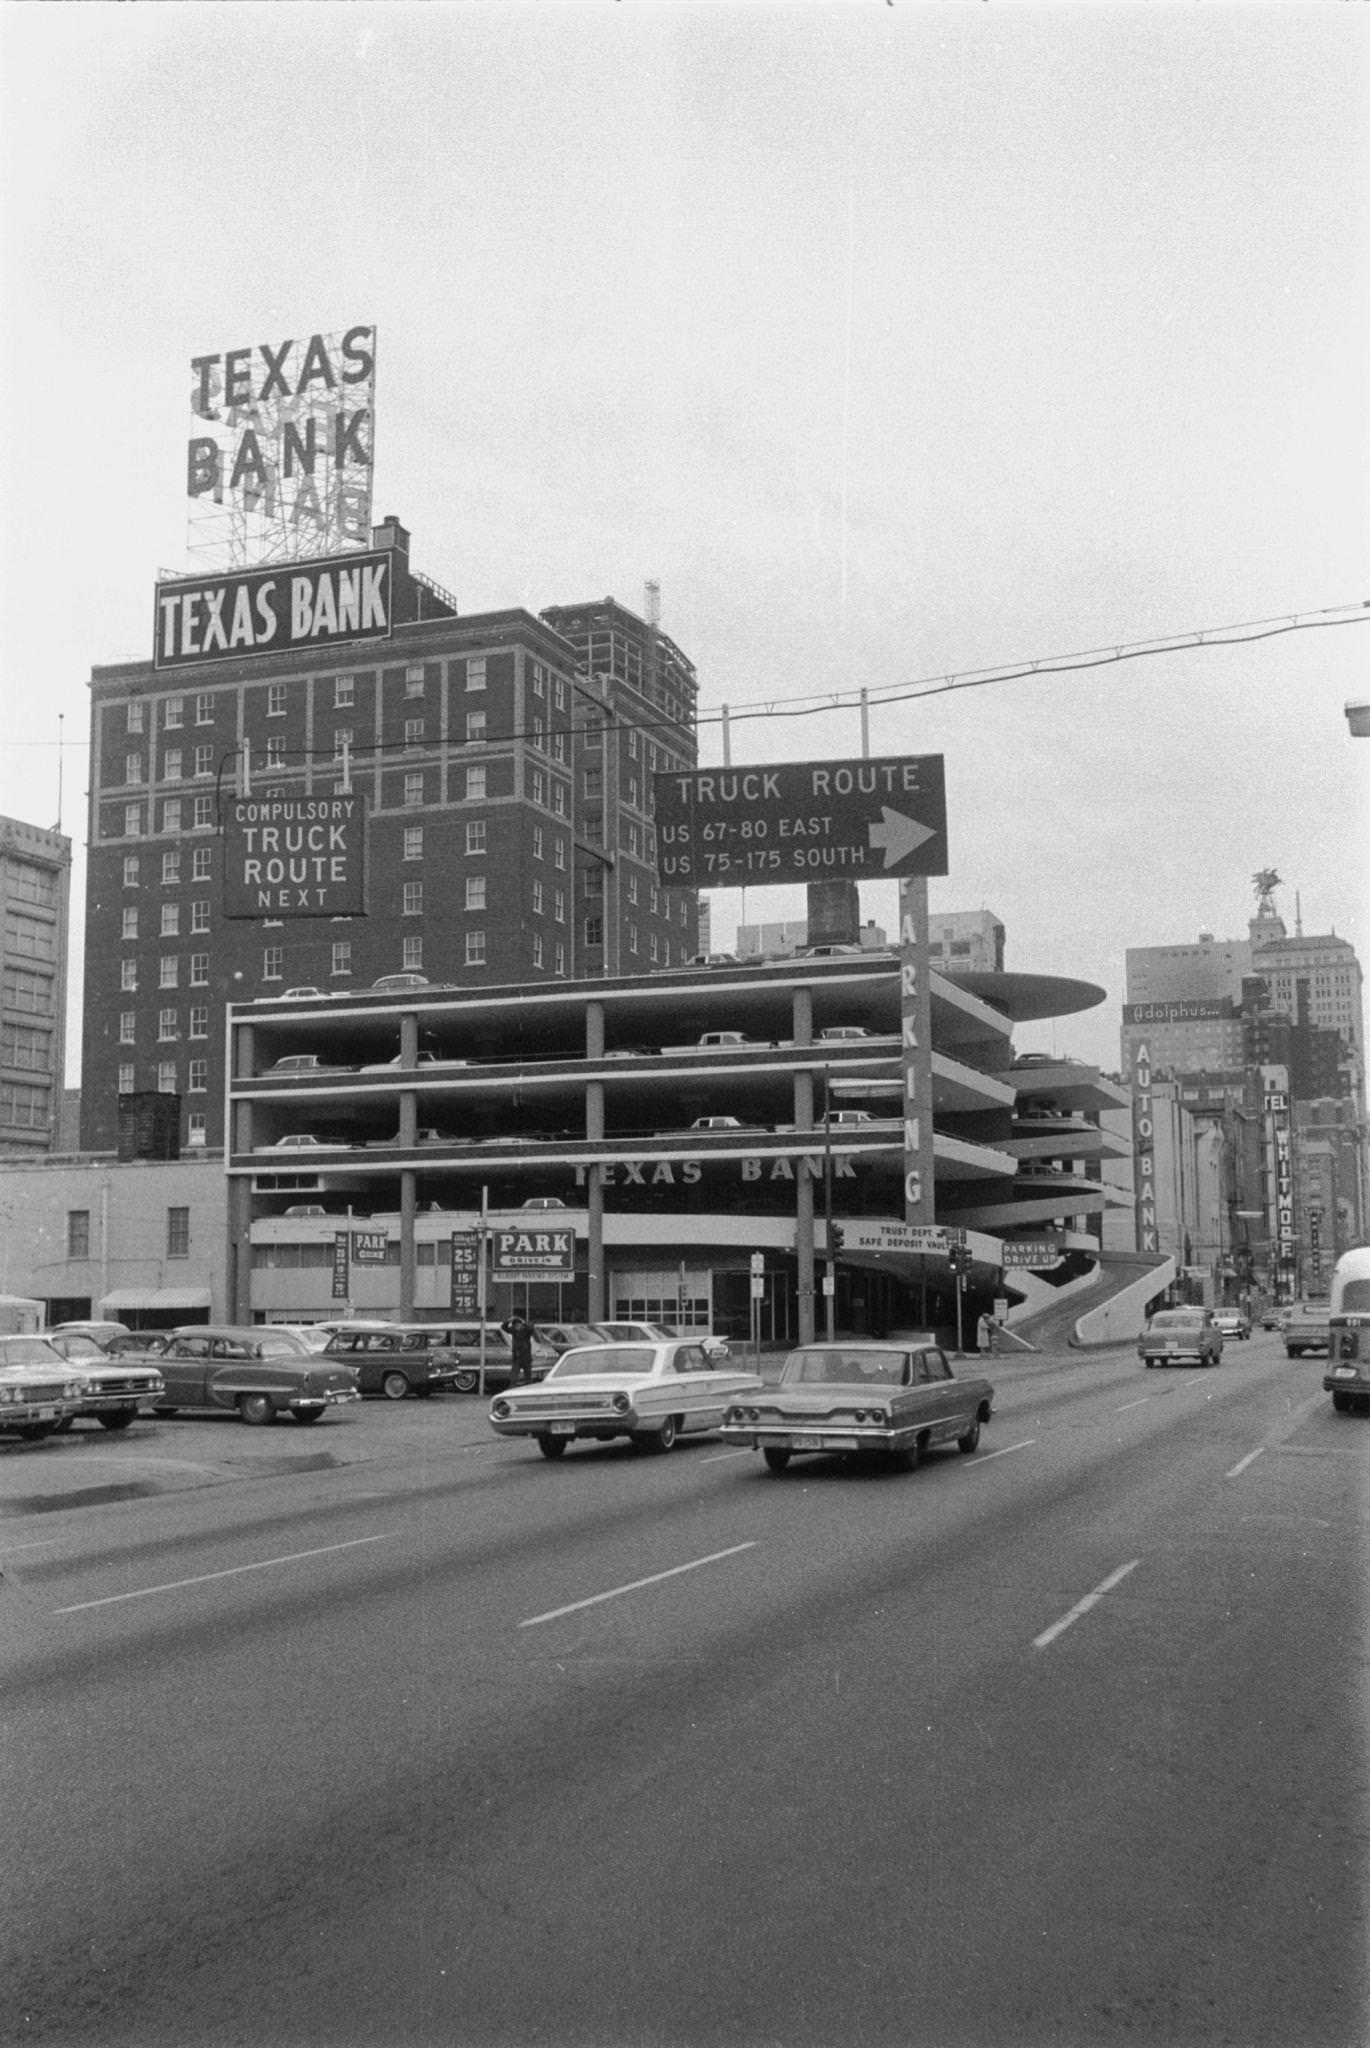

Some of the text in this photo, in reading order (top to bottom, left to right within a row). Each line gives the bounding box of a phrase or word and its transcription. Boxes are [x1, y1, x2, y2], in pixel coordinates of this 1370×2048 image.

[191, 326, 373, 412] TEXAS
[187, 408, 369, 498] BANK
[159, 563, 387, 658] TEXAS BANK
[676, 765, 920, 803] TRUCK ROUTE
[235, 801, 354, 822] COMPULSORY
[242, 825, 347, 853] TRUCK
[662, 817, 832, 843] US 67-80 EAST
[244, 857, 347, 884] ROUTE
[664, 847, 865, 874] US 75-175 SOUTH
[258, 889, 327, 907] NEXT
[570, 1154, 857, 1186] TEXAS BANK
[499, 1234, 569, 1252] PARK
[859, 1237, 883, 1247] SAFE
[887, 1238, 923, 1249] DEPOSIT
[880, 1226, 908, 1237] TRUST
[1003, 1243, 1056, 1254] PARKING
[1004, 1254, 1057, 1265] DRIVE UP
